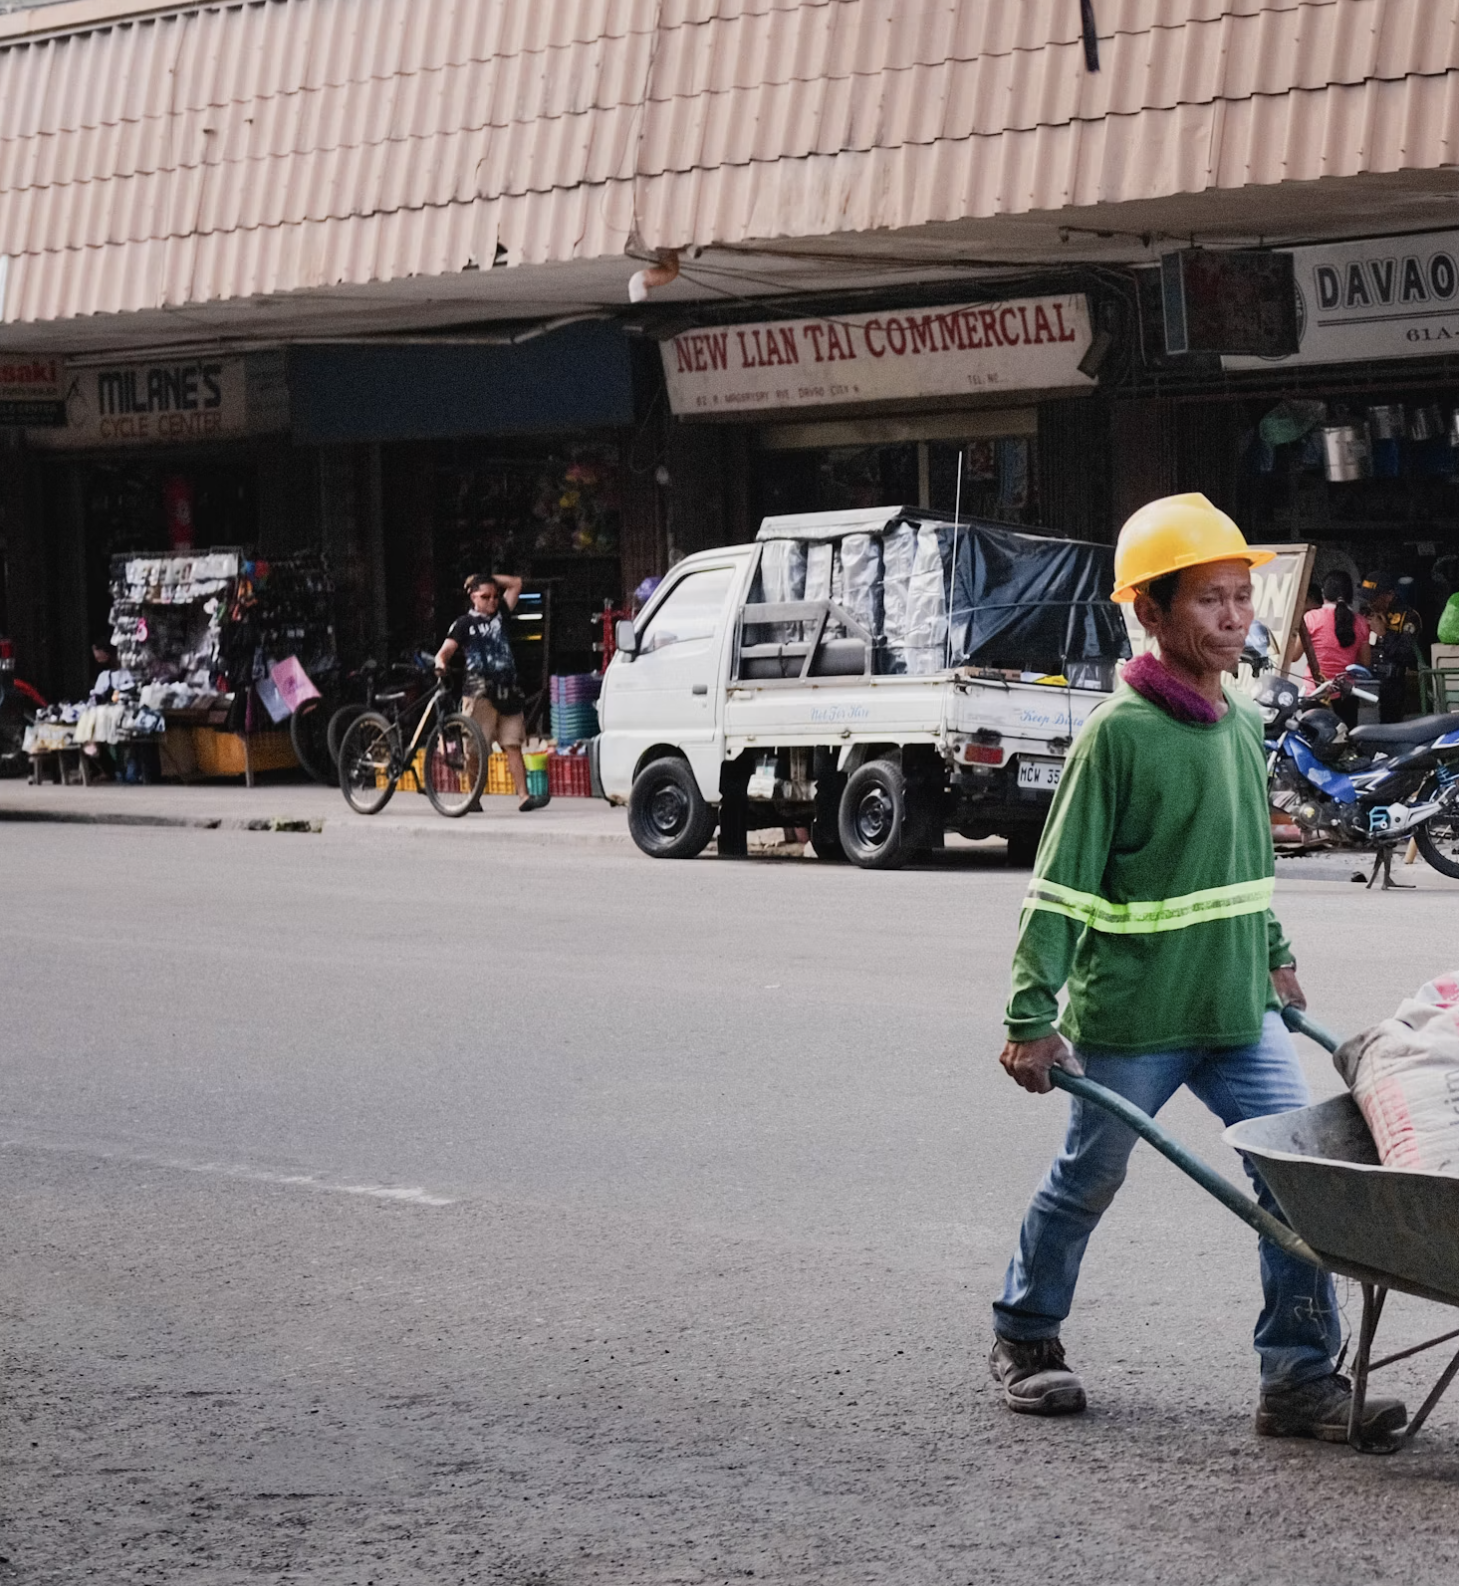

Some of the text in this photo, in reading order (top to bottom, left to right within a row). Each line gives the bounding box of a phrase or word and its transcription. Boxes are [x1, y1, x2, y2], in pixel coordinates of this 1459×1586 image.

[1315, 253, 1459, 309] DAVAO
[676, 302, 1077, 374] NEW LIAN TAI COMMERCIAL
[98, 361, 222, 415] MILANE'S
[101, 410, 222, 439] CYCLE CENTER
[1020, 708, 1050, 727] Keep
[1020, 766, 1060, 785] MCW 35
